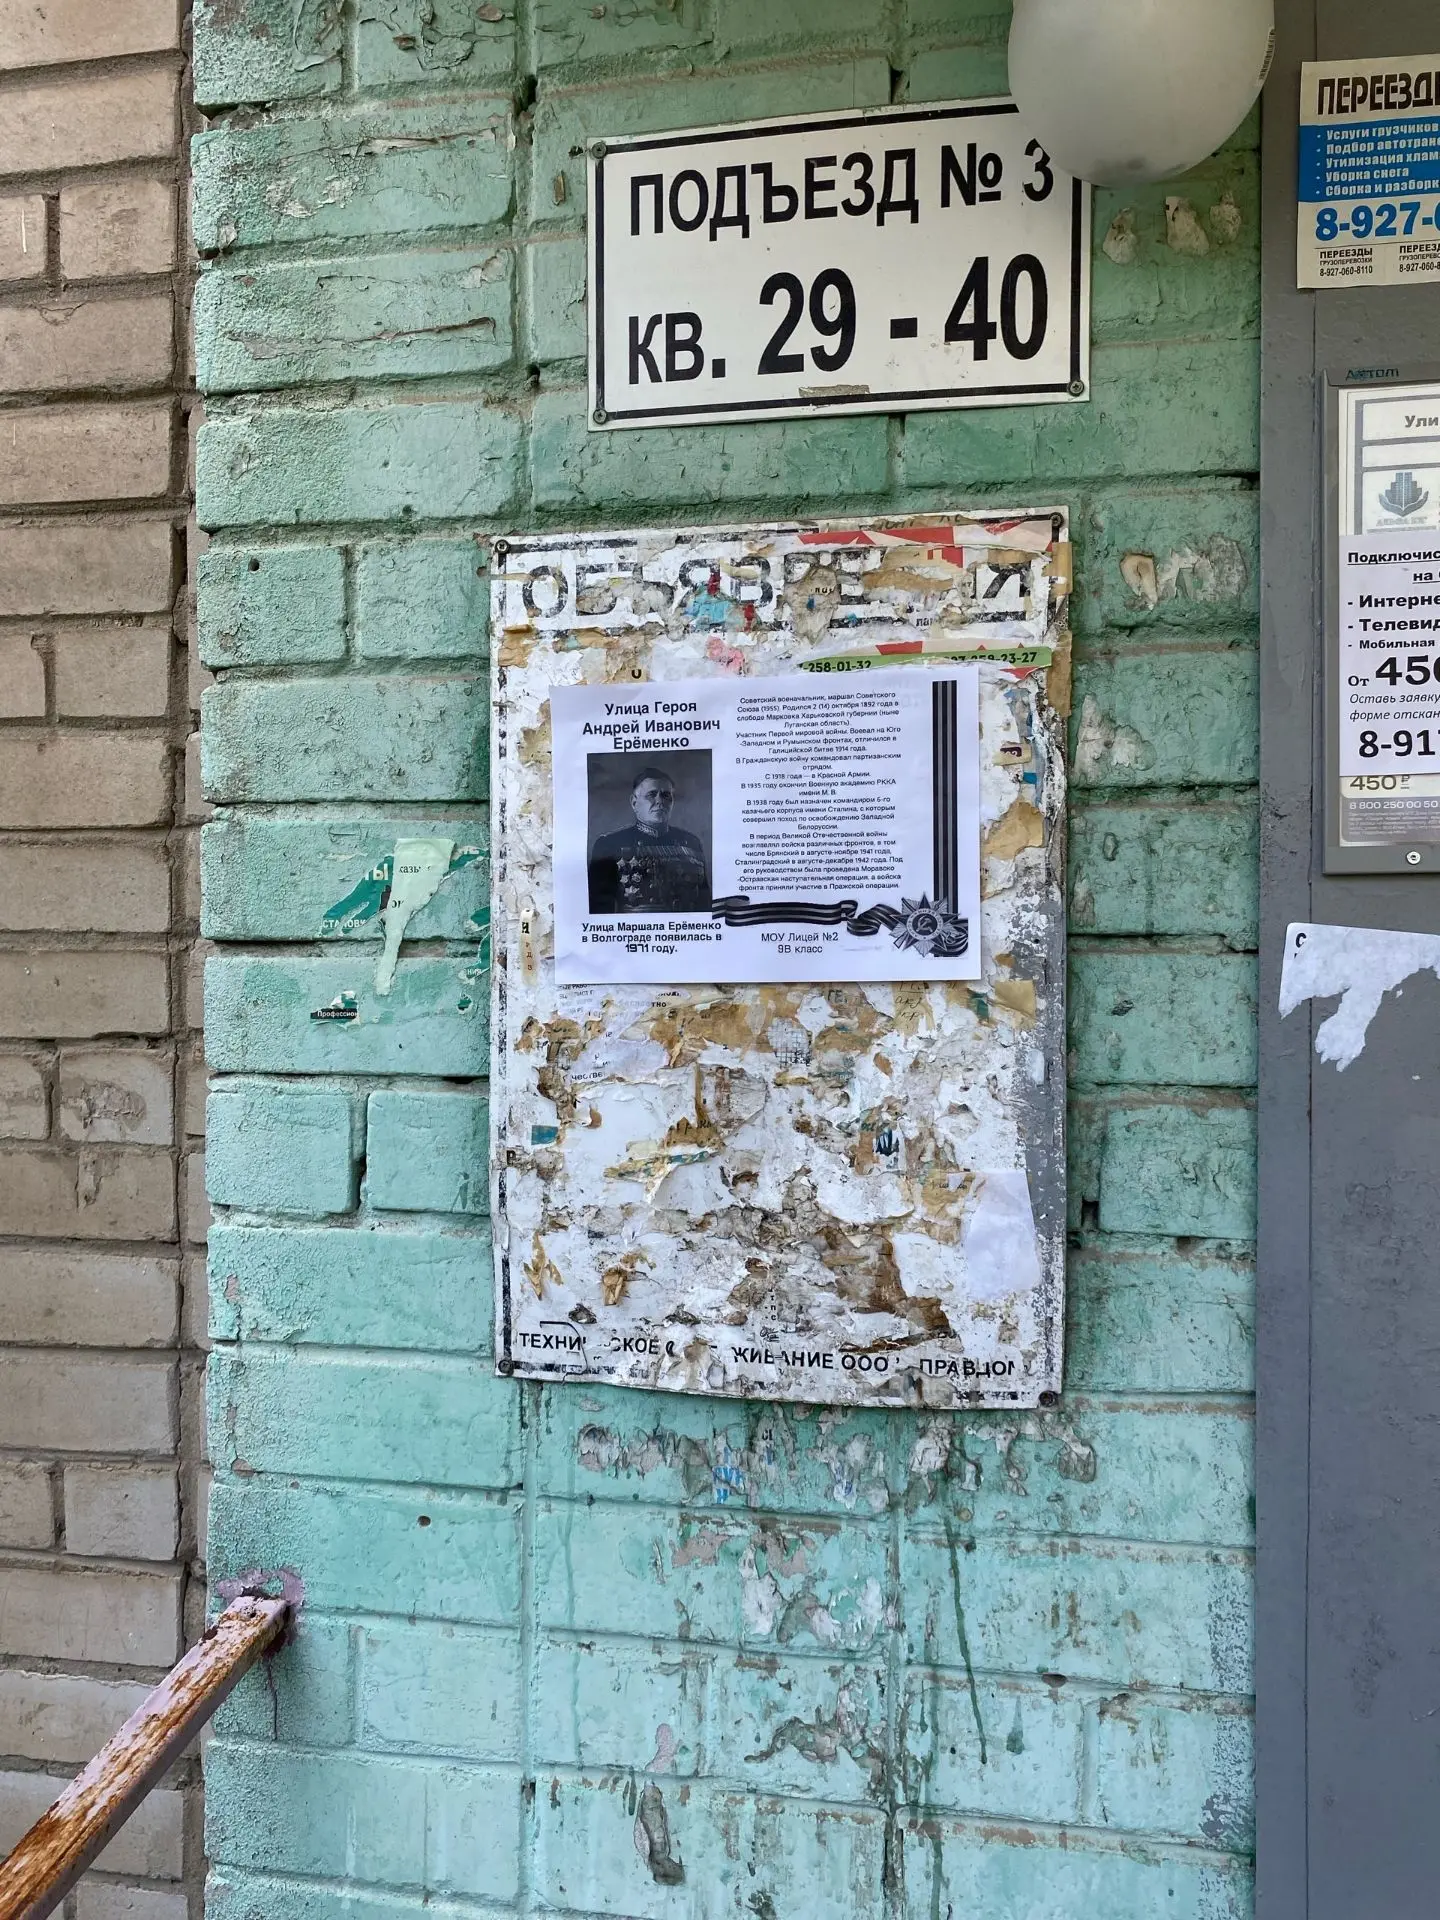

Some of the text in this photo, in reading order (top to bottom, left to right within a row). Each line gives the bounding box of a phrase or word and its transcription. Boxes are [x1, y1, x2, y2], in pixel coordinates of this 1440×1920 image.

[1318, 72, 1440, 115] ПЕРЕЕЗД
[1327, 123, 1438, 140] Услуги грузчиков
[1327, 142, 1374, 155] Подбор
[1326, 155, 1403, 168] Утилизация
[1326, 168, 1409, 182] Уборка снега
[630, 138, 1054, 242] ПОДЪЕЗД № 3
[1326, 185, 1371, 196] Сборка
[1374, 184, 1382, 192] и
[1316, 202, 1440, 241] 8-927-
[1320, 248, 1372, 258] ПЕРЕЕЗДЫ
[1320, 257, 1372, 265] ГРУЗОПЕРЕВОЗКИ
[1320, 266, 1372, 276] 8-927-060-8110
[629, 253, 1048, 385] КВ. 29 - 40
[1405, 415, 1438, 428] Ули
[1414, 572, 1433, 581] на
[1360, 640, 1435, 649] Мобильная
[1348, 676, 1369, 686] От
[1350, 693, 1440, 705] Оставь заявку
[605, 702, 697, 715] Улица Героя
[1350, 710, 1440, 722] форме отскан
[583, 720, 720, 736] Андрей Иванович
[614, 737, 689, 752] Ерёменко
[1359, 730, 1440, 758] 8-91
[1350, 775, 1397, 790] 450
[582, 921, 722, 932] Улица Маршала Ерёменко
[591, 934, 652, 943] Волгограде
[761, 931, 838, 942] МОУ Лицей №2
[625, 944, 678, 954] 1971 году.
[778, 944, 791, 953] 9В
[842, 1354, 889, 1372] ООО
